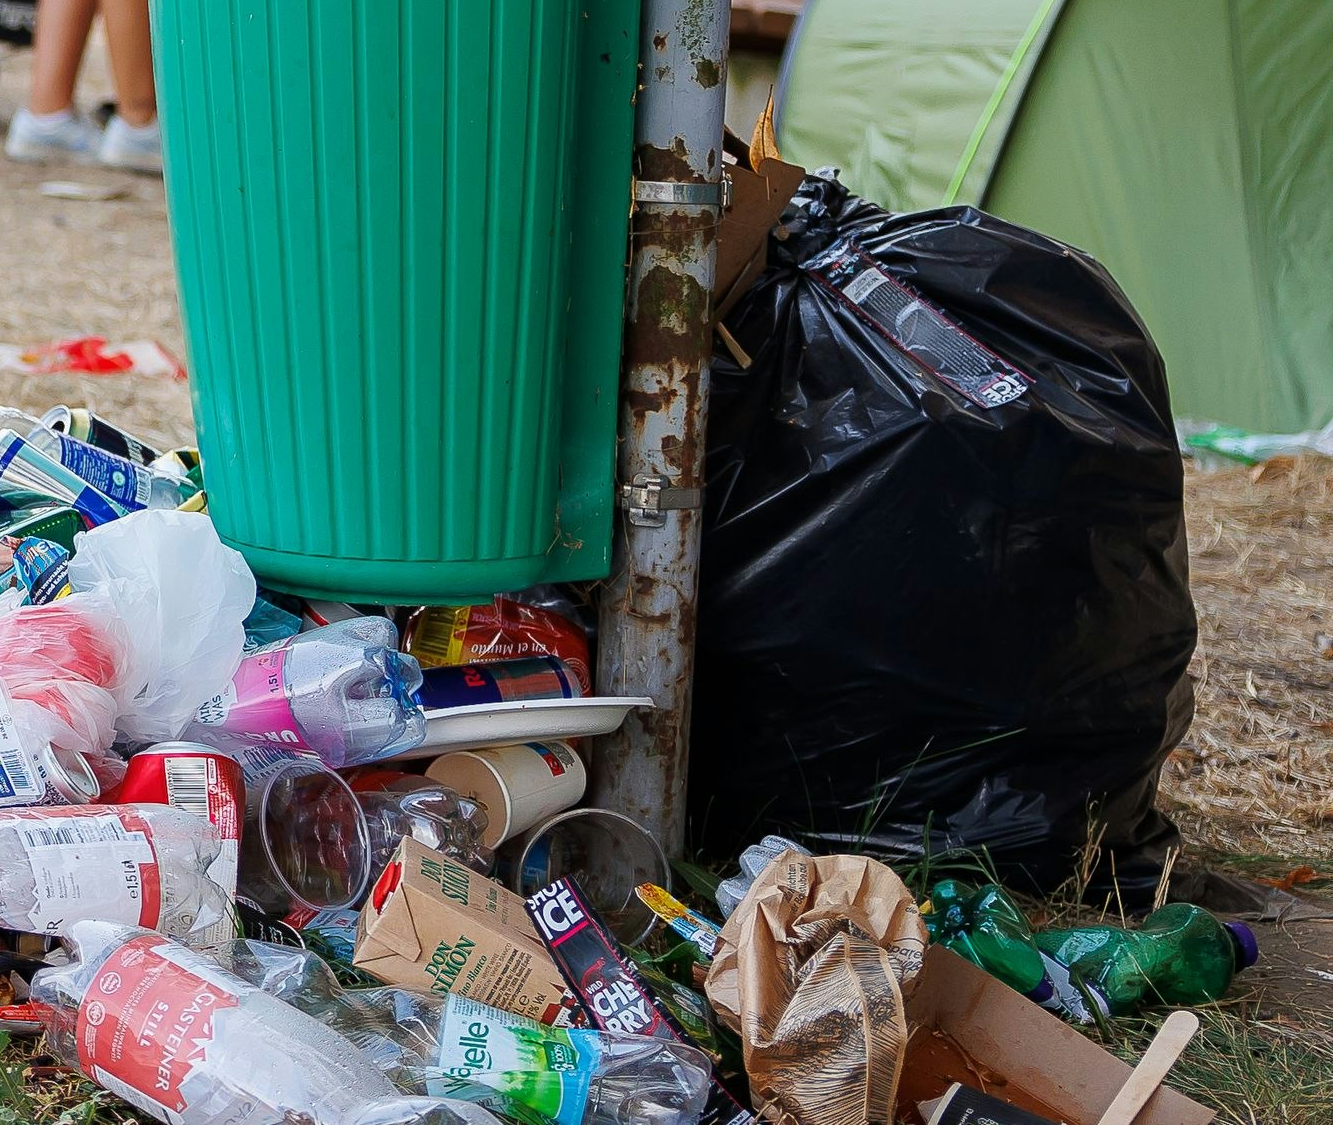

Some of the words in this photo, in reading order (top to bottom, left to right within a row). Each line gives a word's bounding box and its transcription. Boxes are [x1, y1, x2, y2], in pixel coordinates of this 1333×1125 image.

[470, 641, 515, 657] Mundo
[516, 641, 529, 654] el
[531, 641, 547, 654] en
[197, 701, 214, 724] MIN
[211, 694, 225, 721] WAS
[420, 856, 442, 885] DON
[442, 858, 470, 907] SIMON
[533, 889, 585, 941] ICE
[425, 940, 454, 979] DON
[430, 934, 478, 995] SIMON
[466, 955, 488, 986] Blanco
[584, 980, 604, 995] WILD
[139, 1001, 170, 1048] STILL
[155, 991, 216, 1091] GASTEINER
